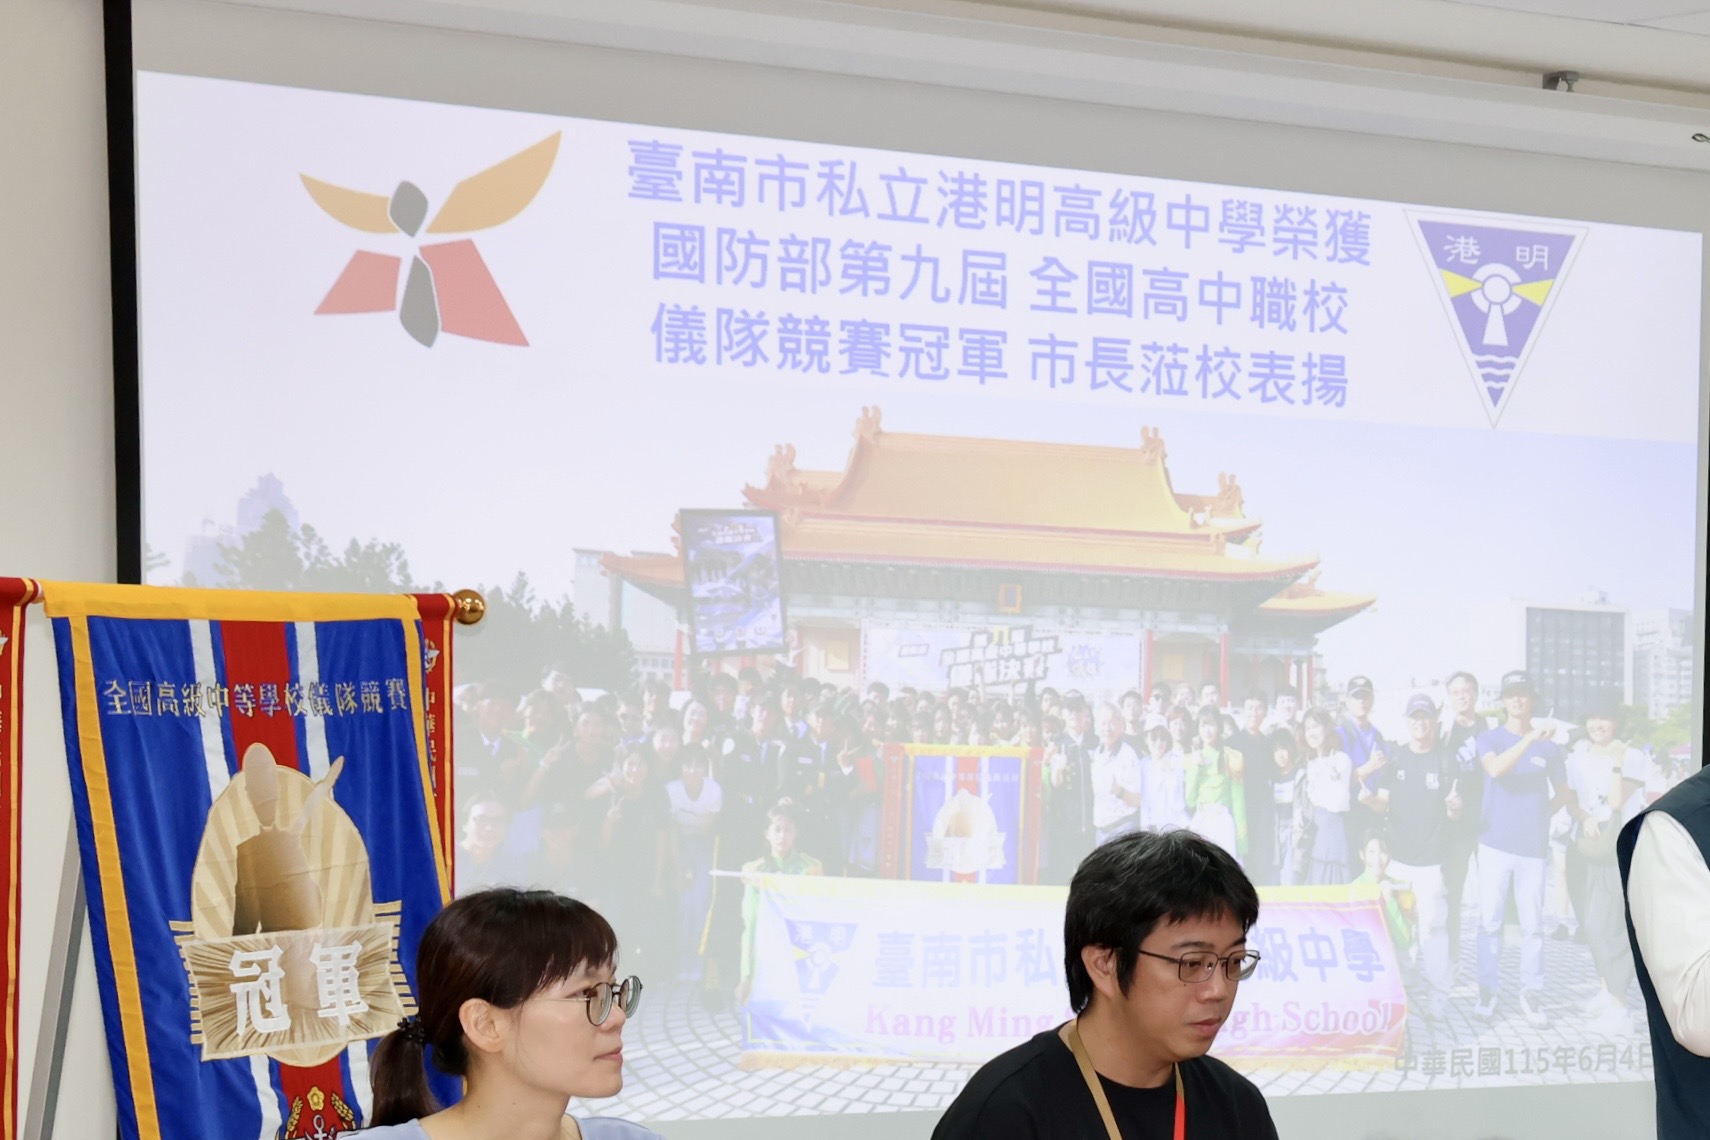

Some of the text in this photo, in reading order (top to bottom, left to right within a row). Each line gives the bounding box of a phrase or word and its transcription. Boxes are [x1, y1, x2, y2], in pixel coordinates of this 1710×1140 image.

[627, 139, 1372, 267] 臺南市私立港明高級中學榮獲
[652, 220, 1349, 335] 國防部第九屆 全國高中職校
[650, 301, 1349, 408] 儀隊競賽冠軍 市長蒞校表揚
[229, 941, 370, 1037] 冠軍
